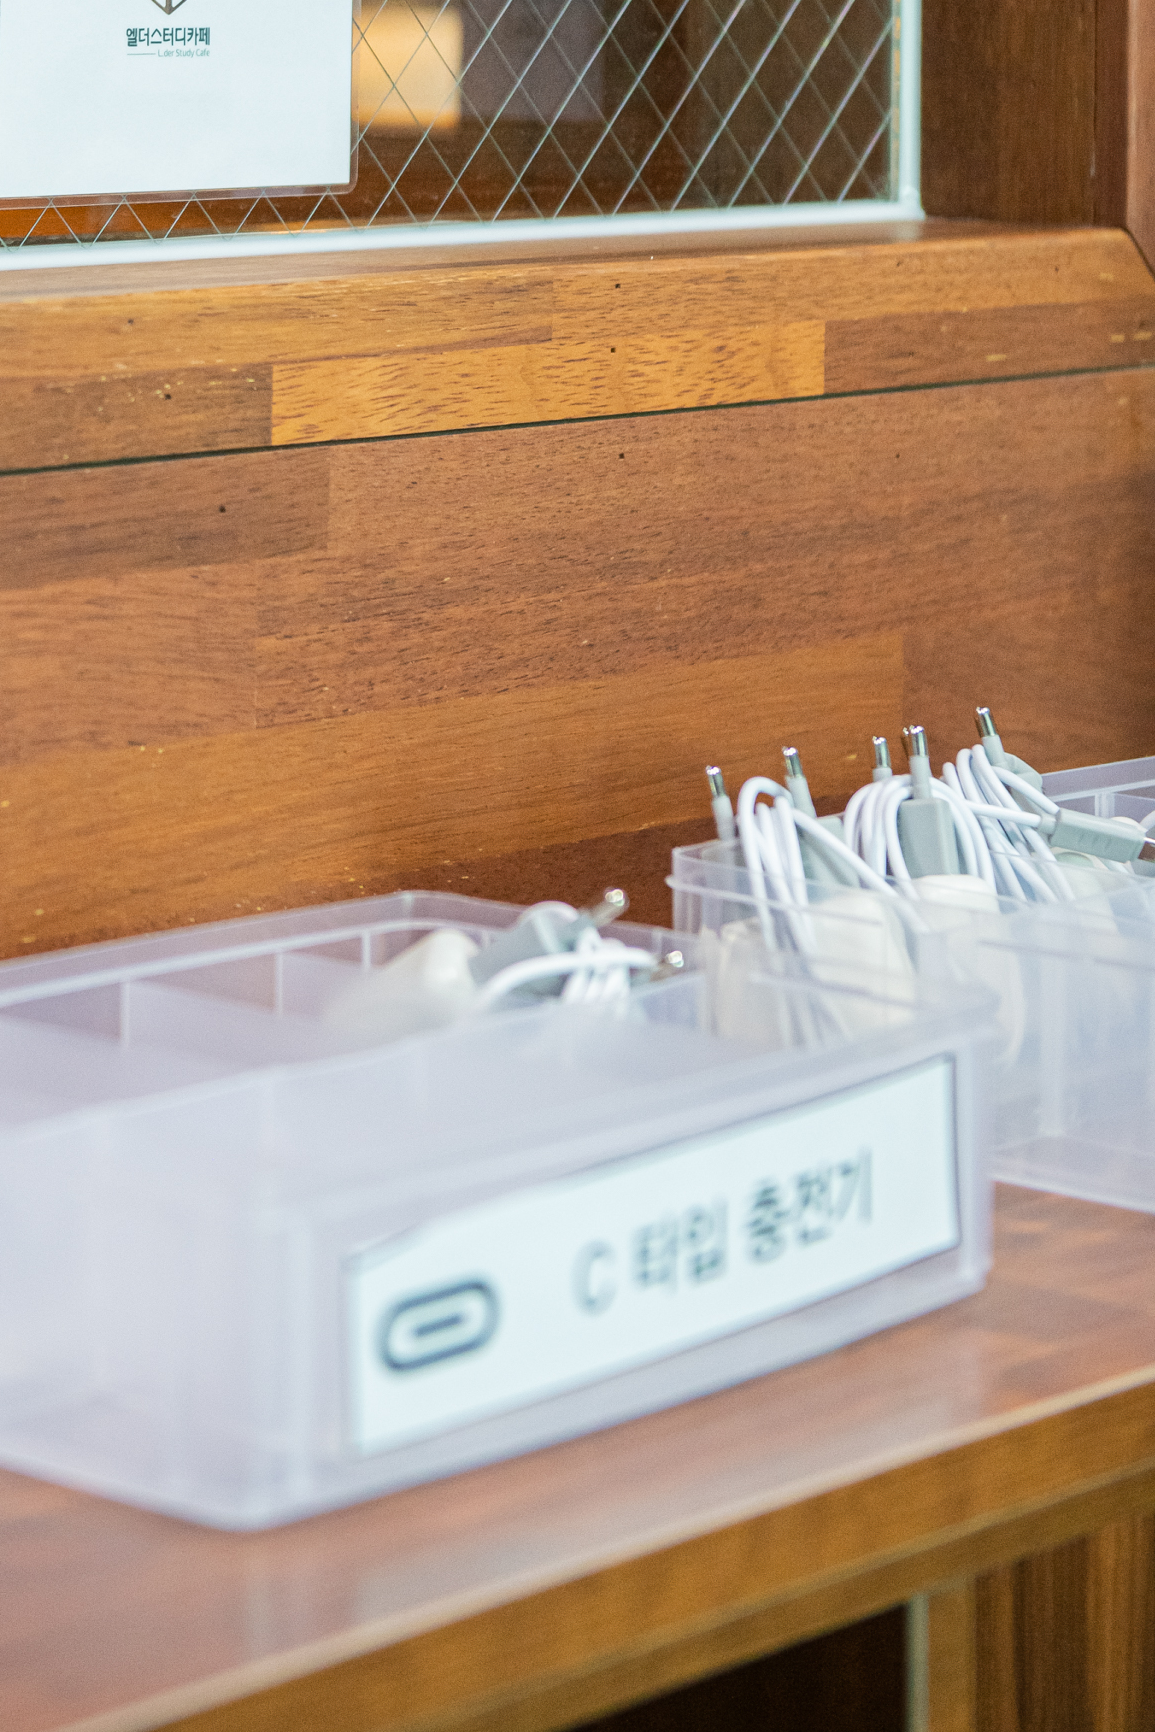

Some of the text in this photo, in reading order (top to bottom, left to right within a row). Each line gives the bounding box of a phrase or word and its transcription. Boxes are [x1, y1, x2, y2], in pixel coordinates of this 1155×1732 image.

[126, 27, 211, 47] 엘더스터디카페
[572, 1148, 875, 1313] C 타입 충전기
